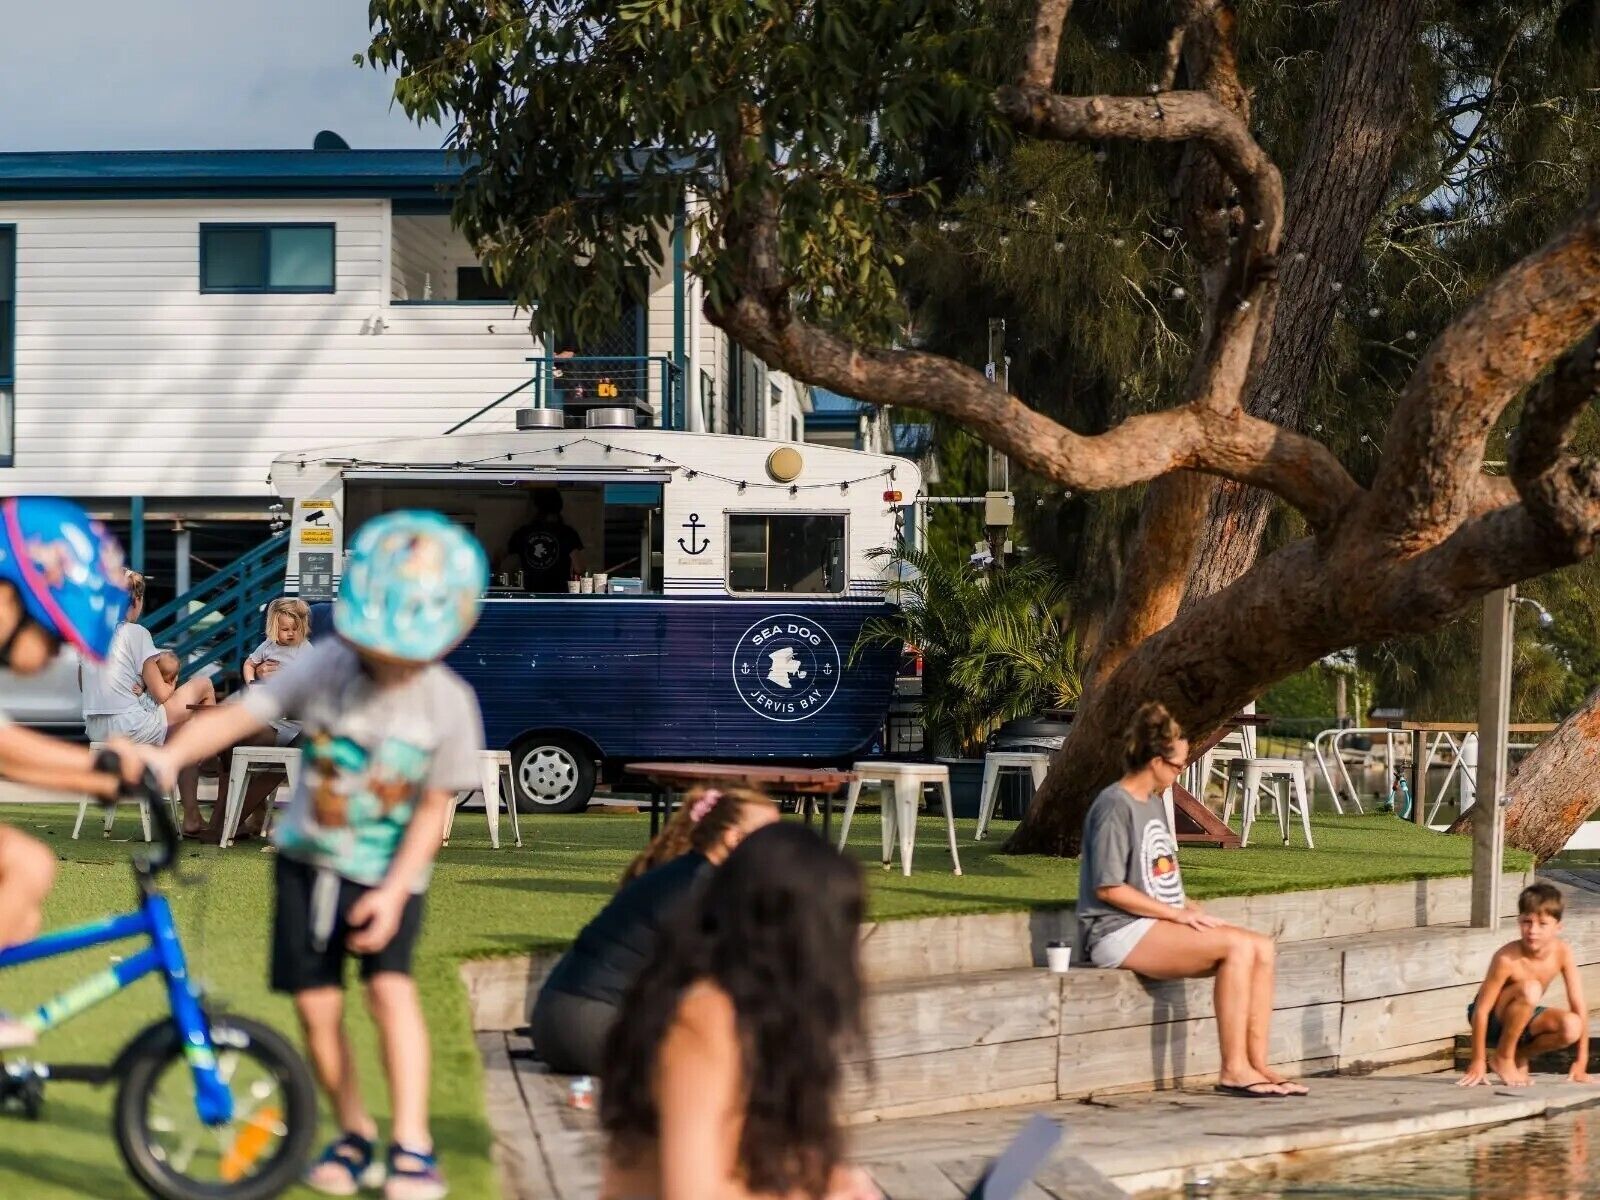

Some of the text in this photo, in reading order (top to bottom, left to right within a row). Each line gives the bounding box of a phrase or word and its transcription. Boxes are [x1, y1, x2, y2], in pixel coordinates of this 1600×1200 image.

[752, 624, 821, 646] SEA DOG
[750, 689, 822, 713] JERVIS BAY
